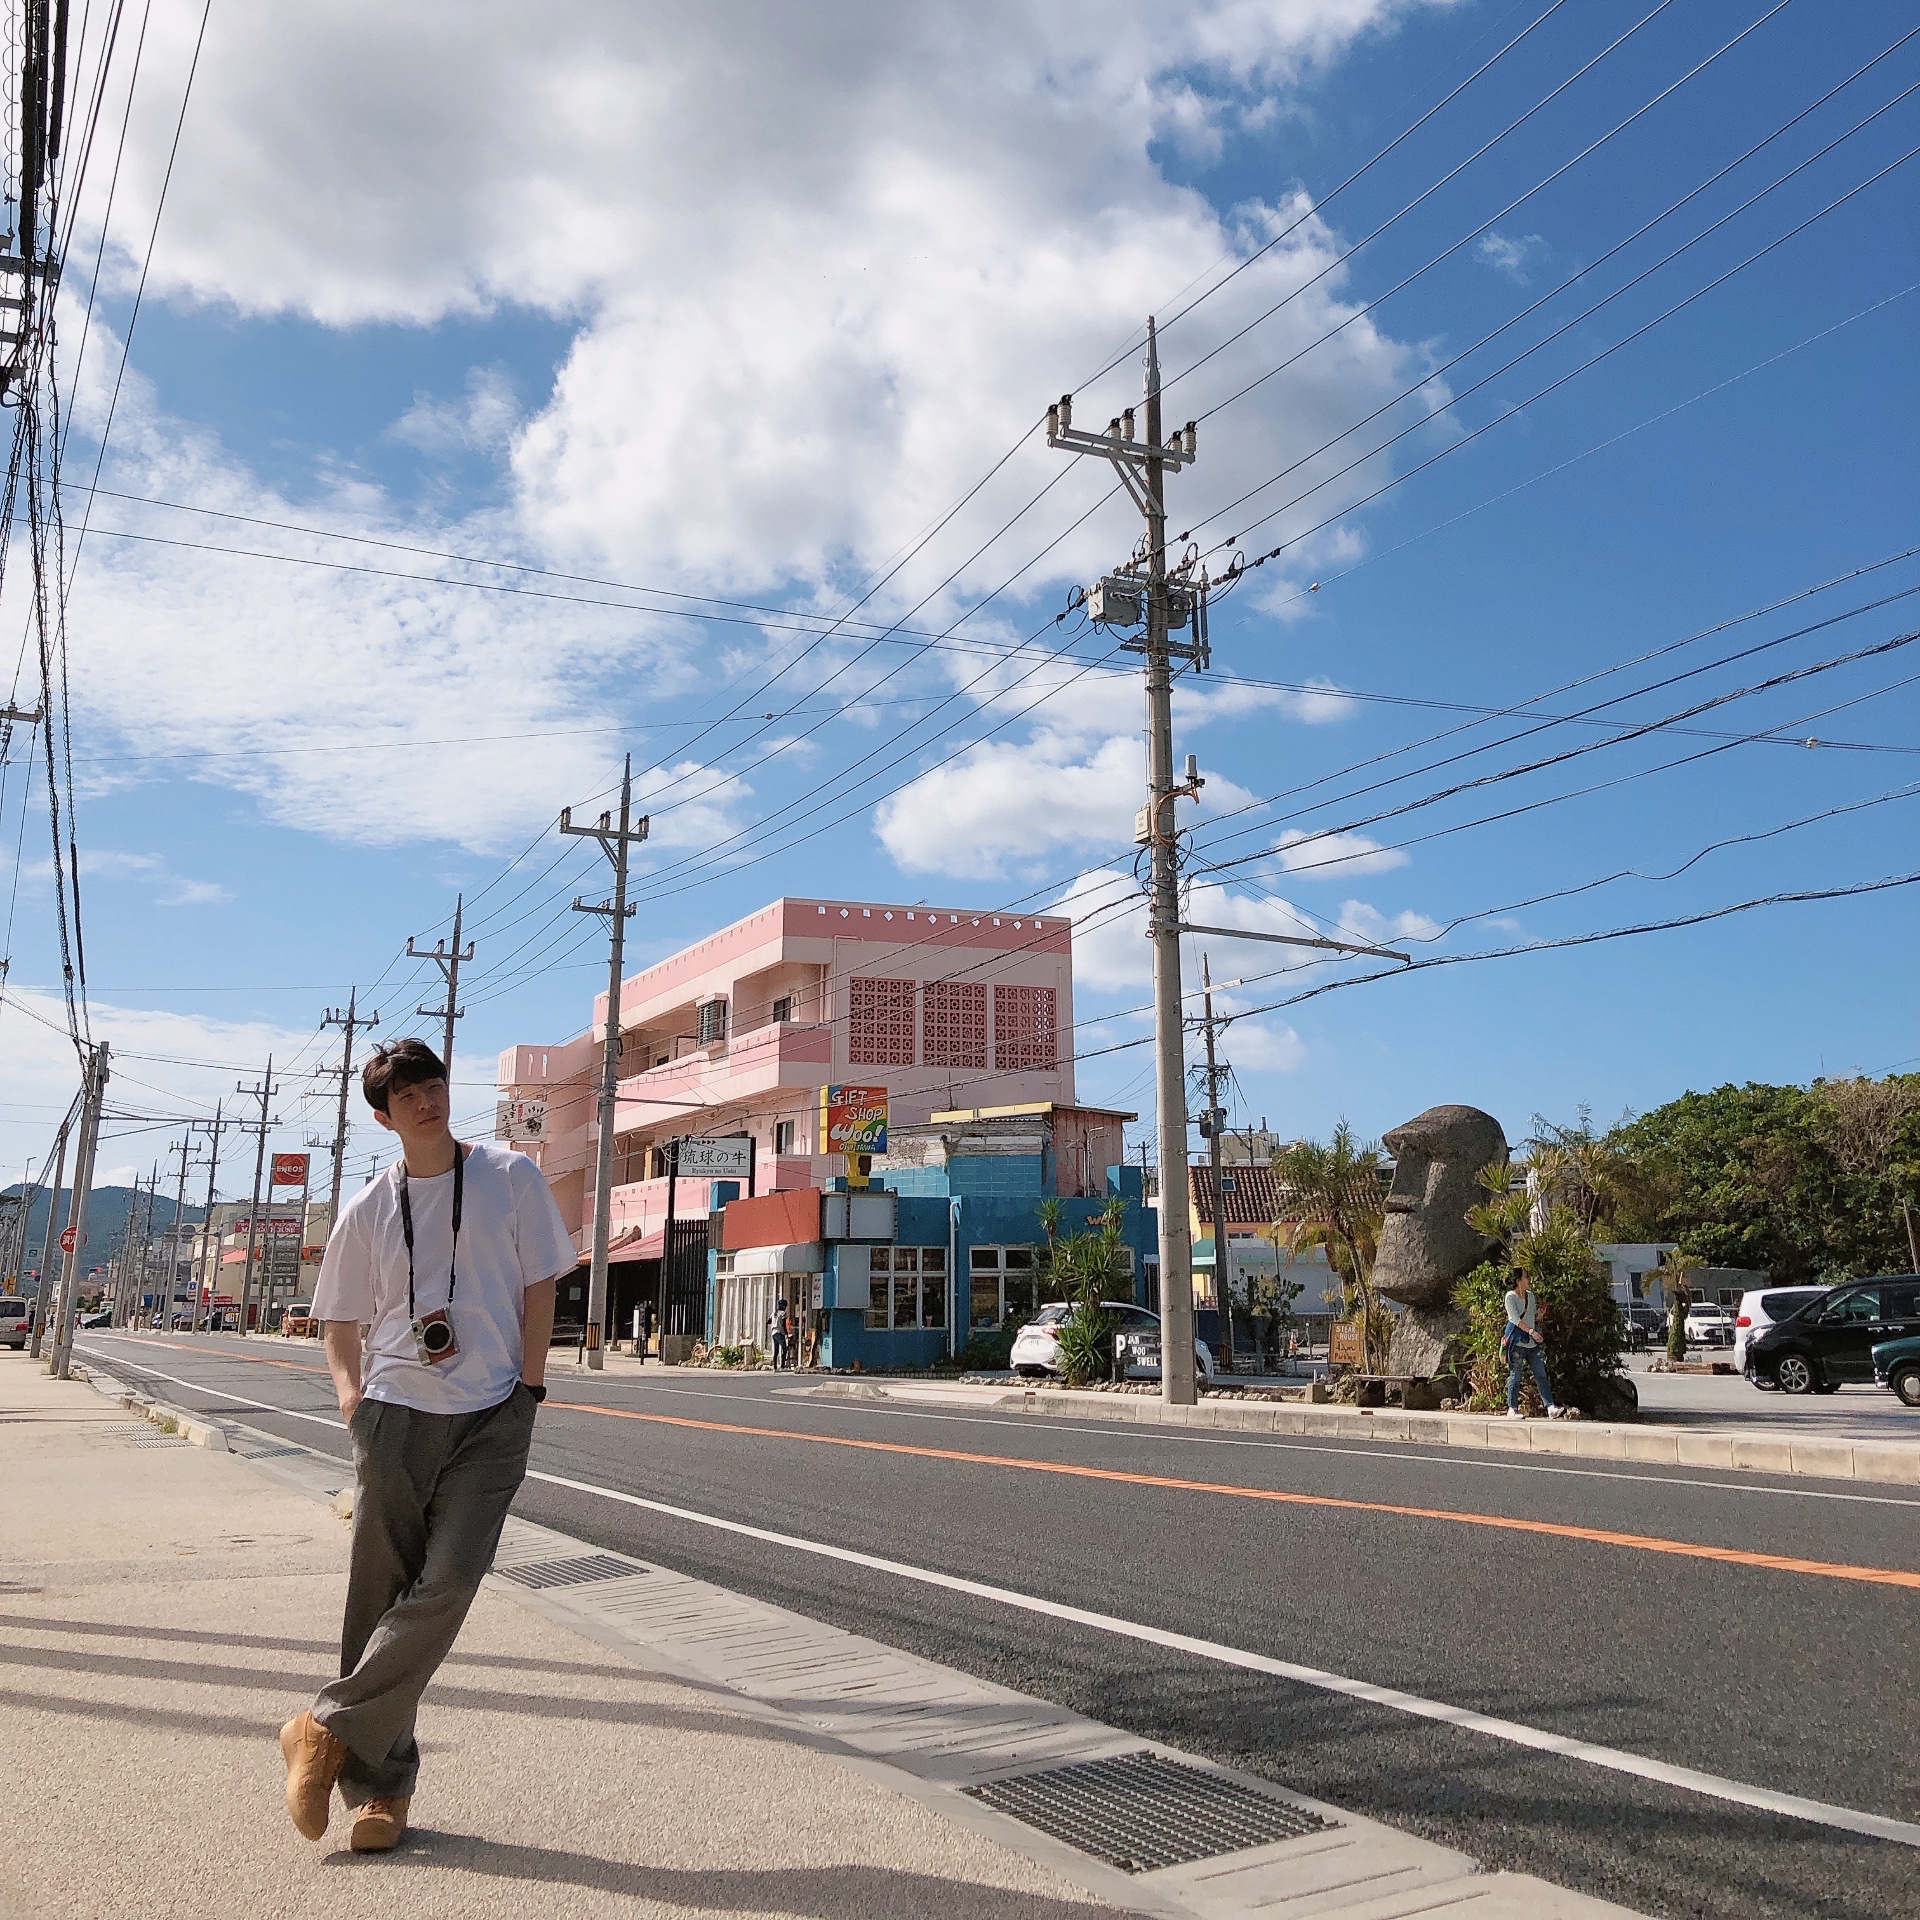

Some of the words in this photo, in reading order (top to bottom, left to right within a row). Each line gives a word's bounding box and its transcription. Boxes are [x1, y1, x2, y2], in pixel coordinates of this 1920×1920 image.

[831, 1090, 867, 1105] GIFT
[845, 1107, 883, 1121] SHOP
[830, 1123, 884, 1143] Woo!
[682, 1149, 747, 1166] 琉球の牛
[276, 1165, 304, 1173] ENEOS
[1335, 1325, 1356, 1334] STEAK
[1127, 1335, 1140, 1345] JAM
[1340, 1333, 1359, 1341] HOUSE
[1115, 1334, 1126, 1359] P
[1131, 1346, 1146, 1356] WOO
[1136, 1356, 1158, 1367] SWELL
